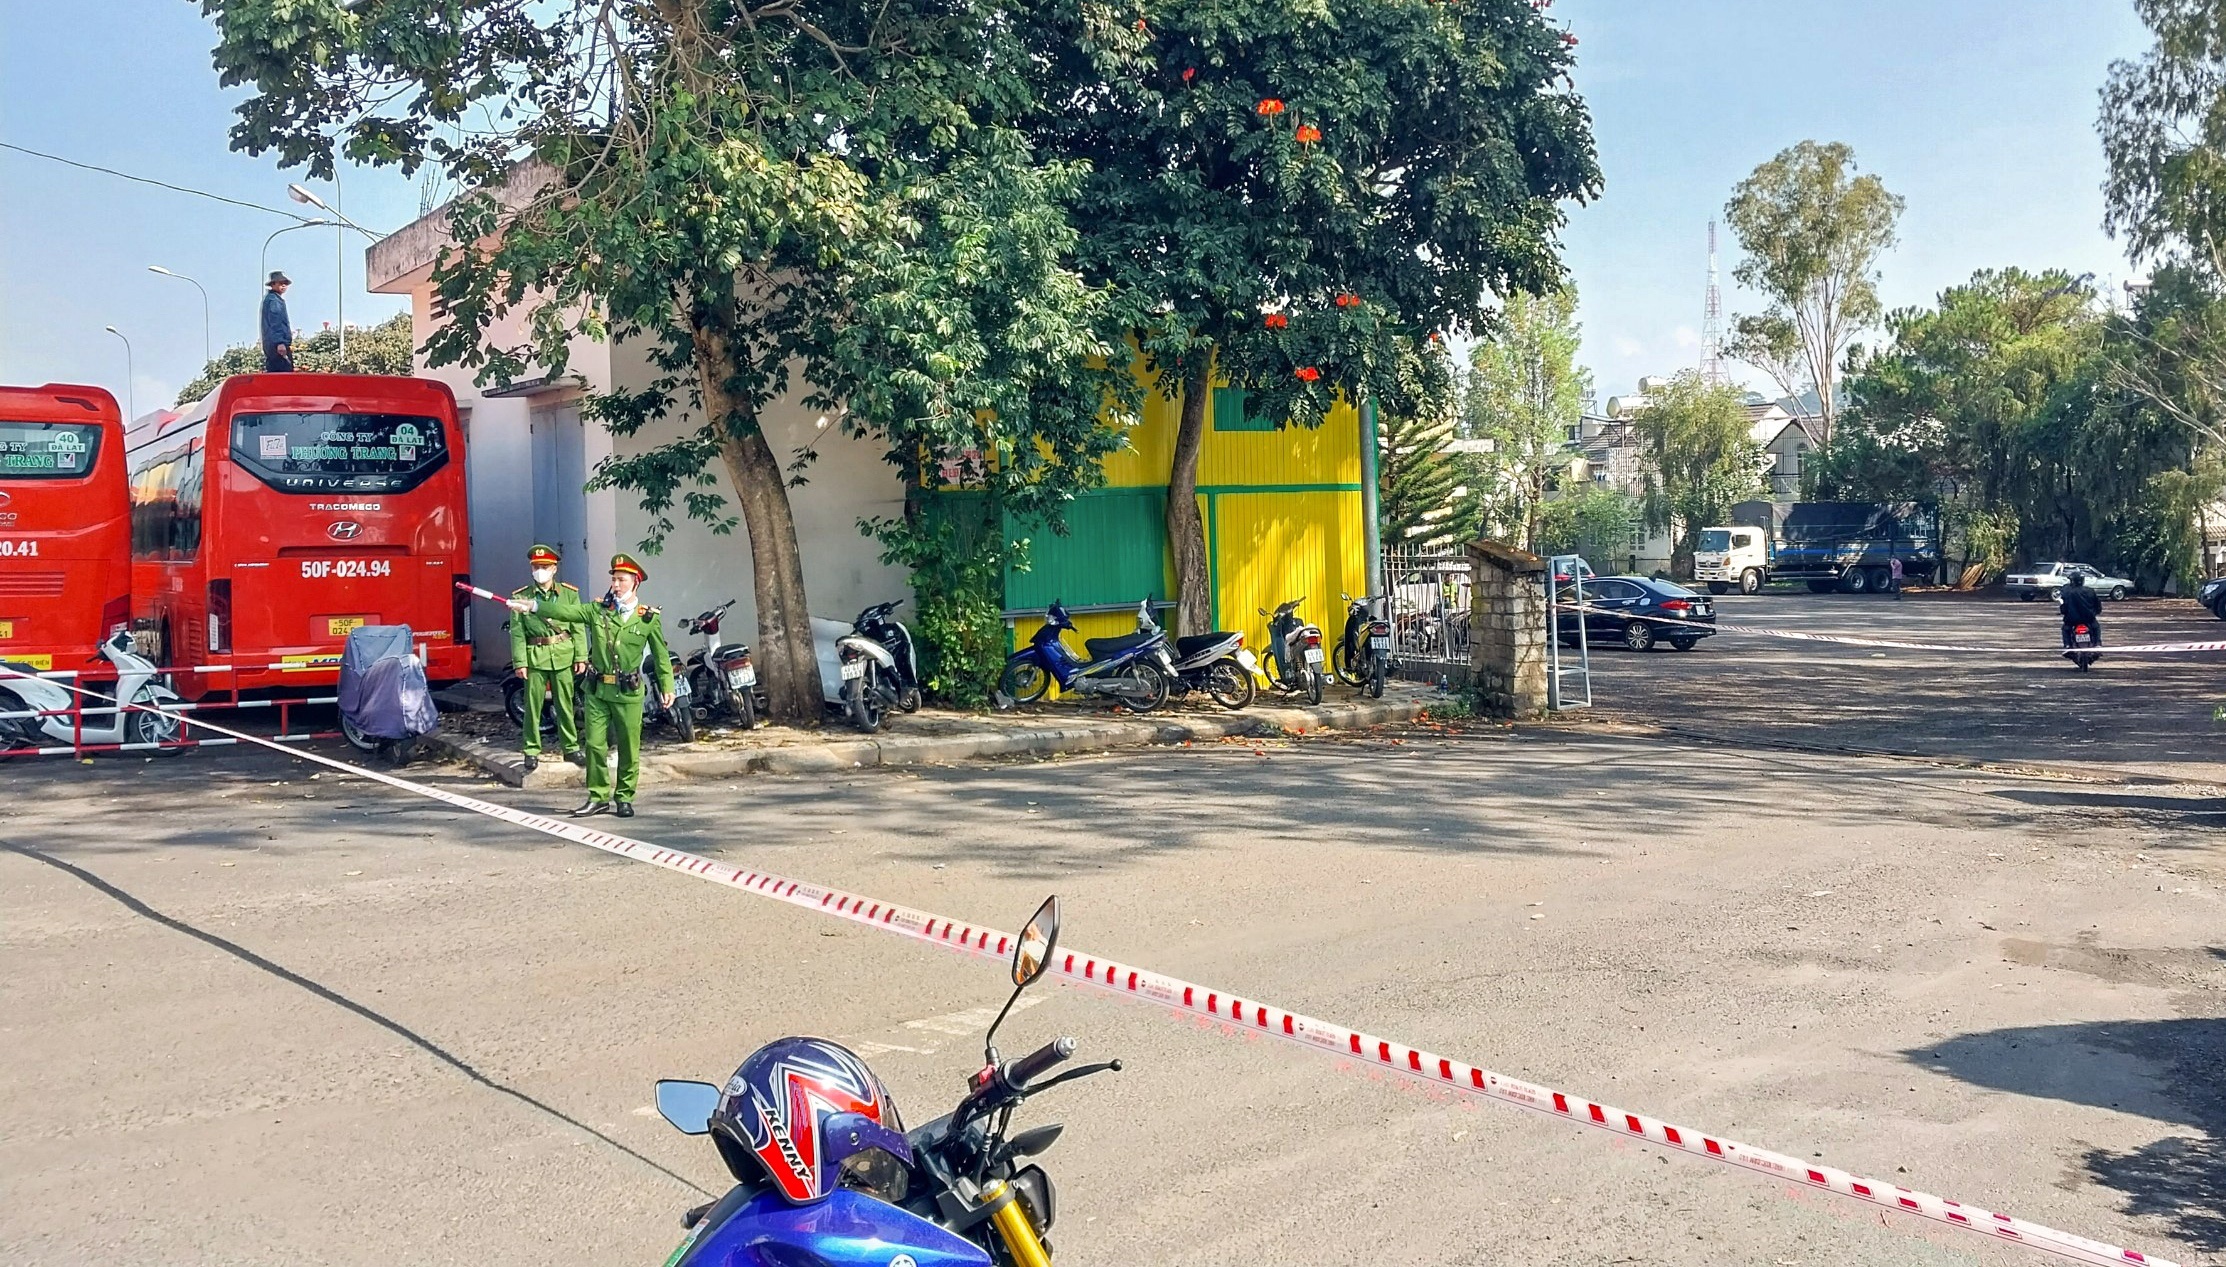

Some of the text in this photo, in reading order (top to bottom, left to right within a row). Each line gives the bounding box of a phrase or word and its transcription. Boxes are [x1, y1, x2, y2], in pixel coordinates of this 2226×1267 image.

[320, 430, 373, 443] CÔNG TY
[401, 426, 414, 435] 04
[59, 434, 74, 443] 40
[10, 442, 27, 452] TY
[351, 446, 397, 461] TRANG
[5, 453, 54, 468] TRANG
[0, 541, 39, 556] 0.41
[301, 560, 391, 578] 50F-024.94
[764, 1108, 812, 1181] KENNY
